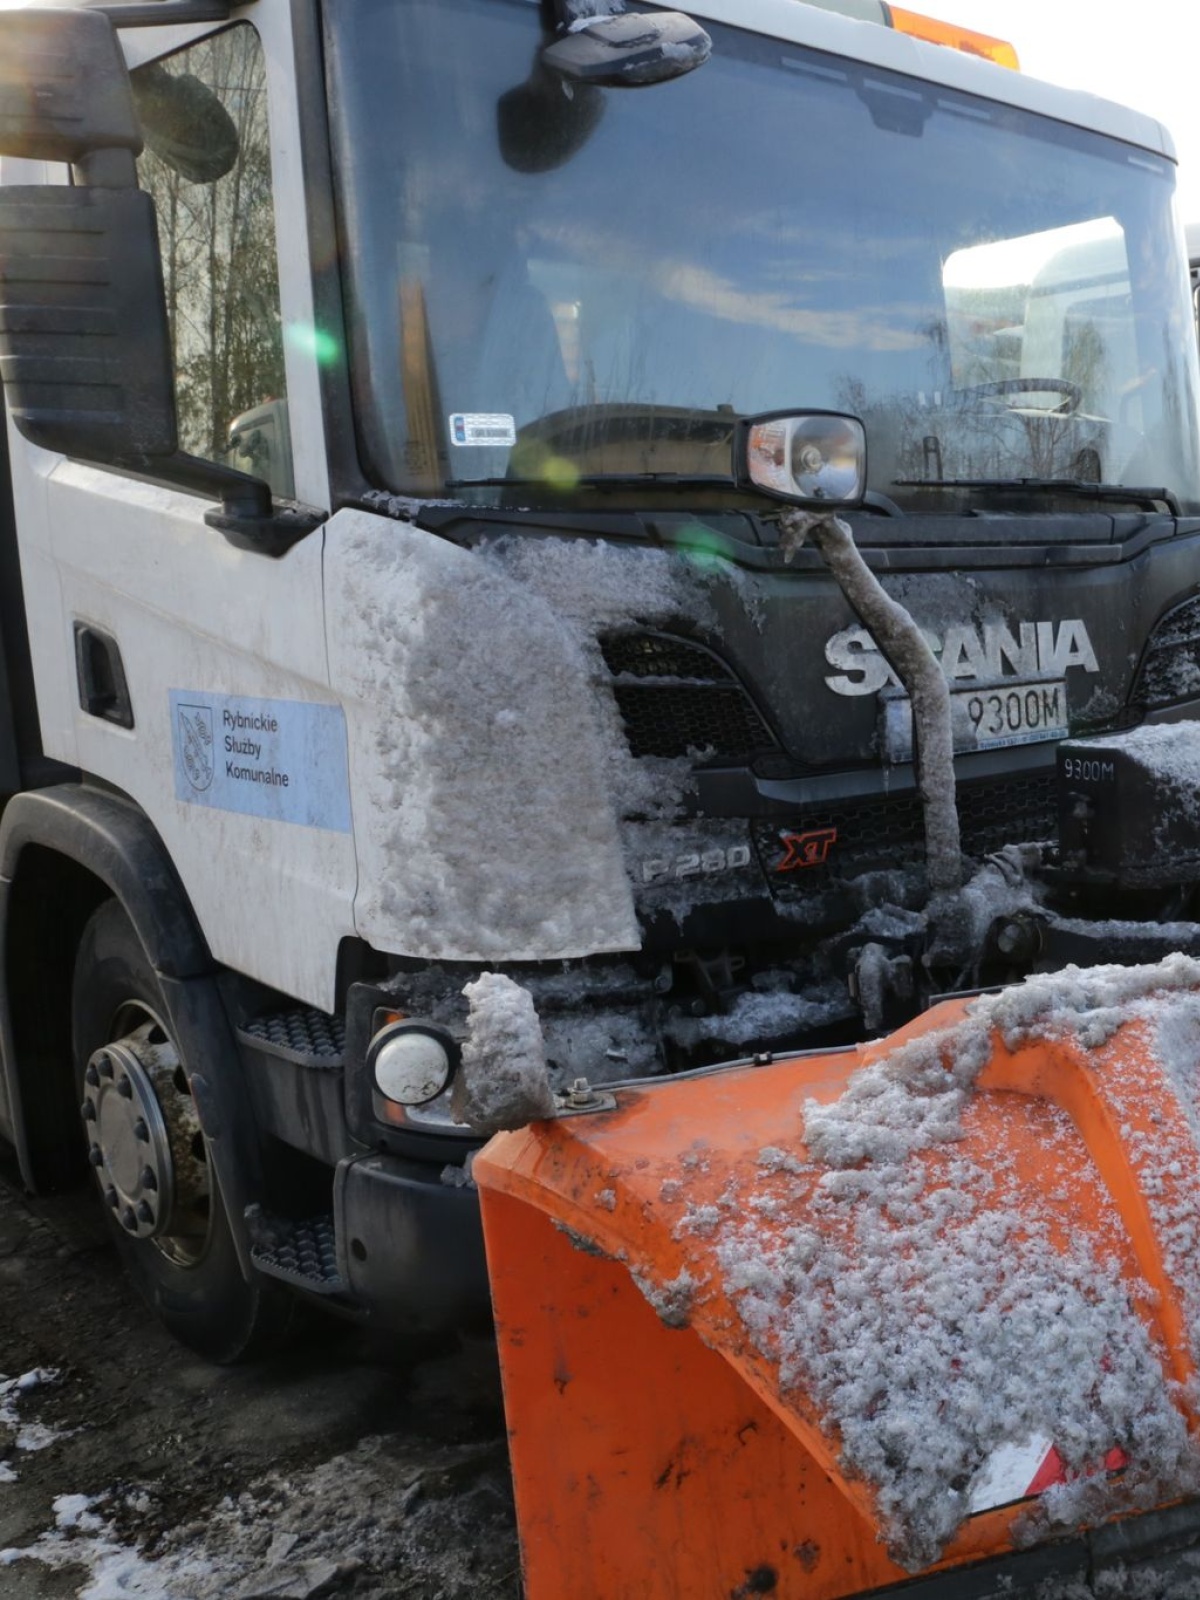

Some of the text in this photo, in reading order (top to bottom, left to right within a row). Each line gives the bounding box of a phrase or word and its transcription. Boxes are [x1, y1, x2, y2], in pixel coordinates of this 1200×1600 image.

[824, 619, 1099, 696] SANIA
[223, 709, 278, 732] Rybnickie
[968, 687, 1060, 734] 9300M
[224, 735, 262, 760] Służby
[225, 760, 289, 787] Komunalne
[1064, 758, 1114, 781] 9300M
[676, 845, 749, 877] 280
[777, 827, 837, 872] XT
